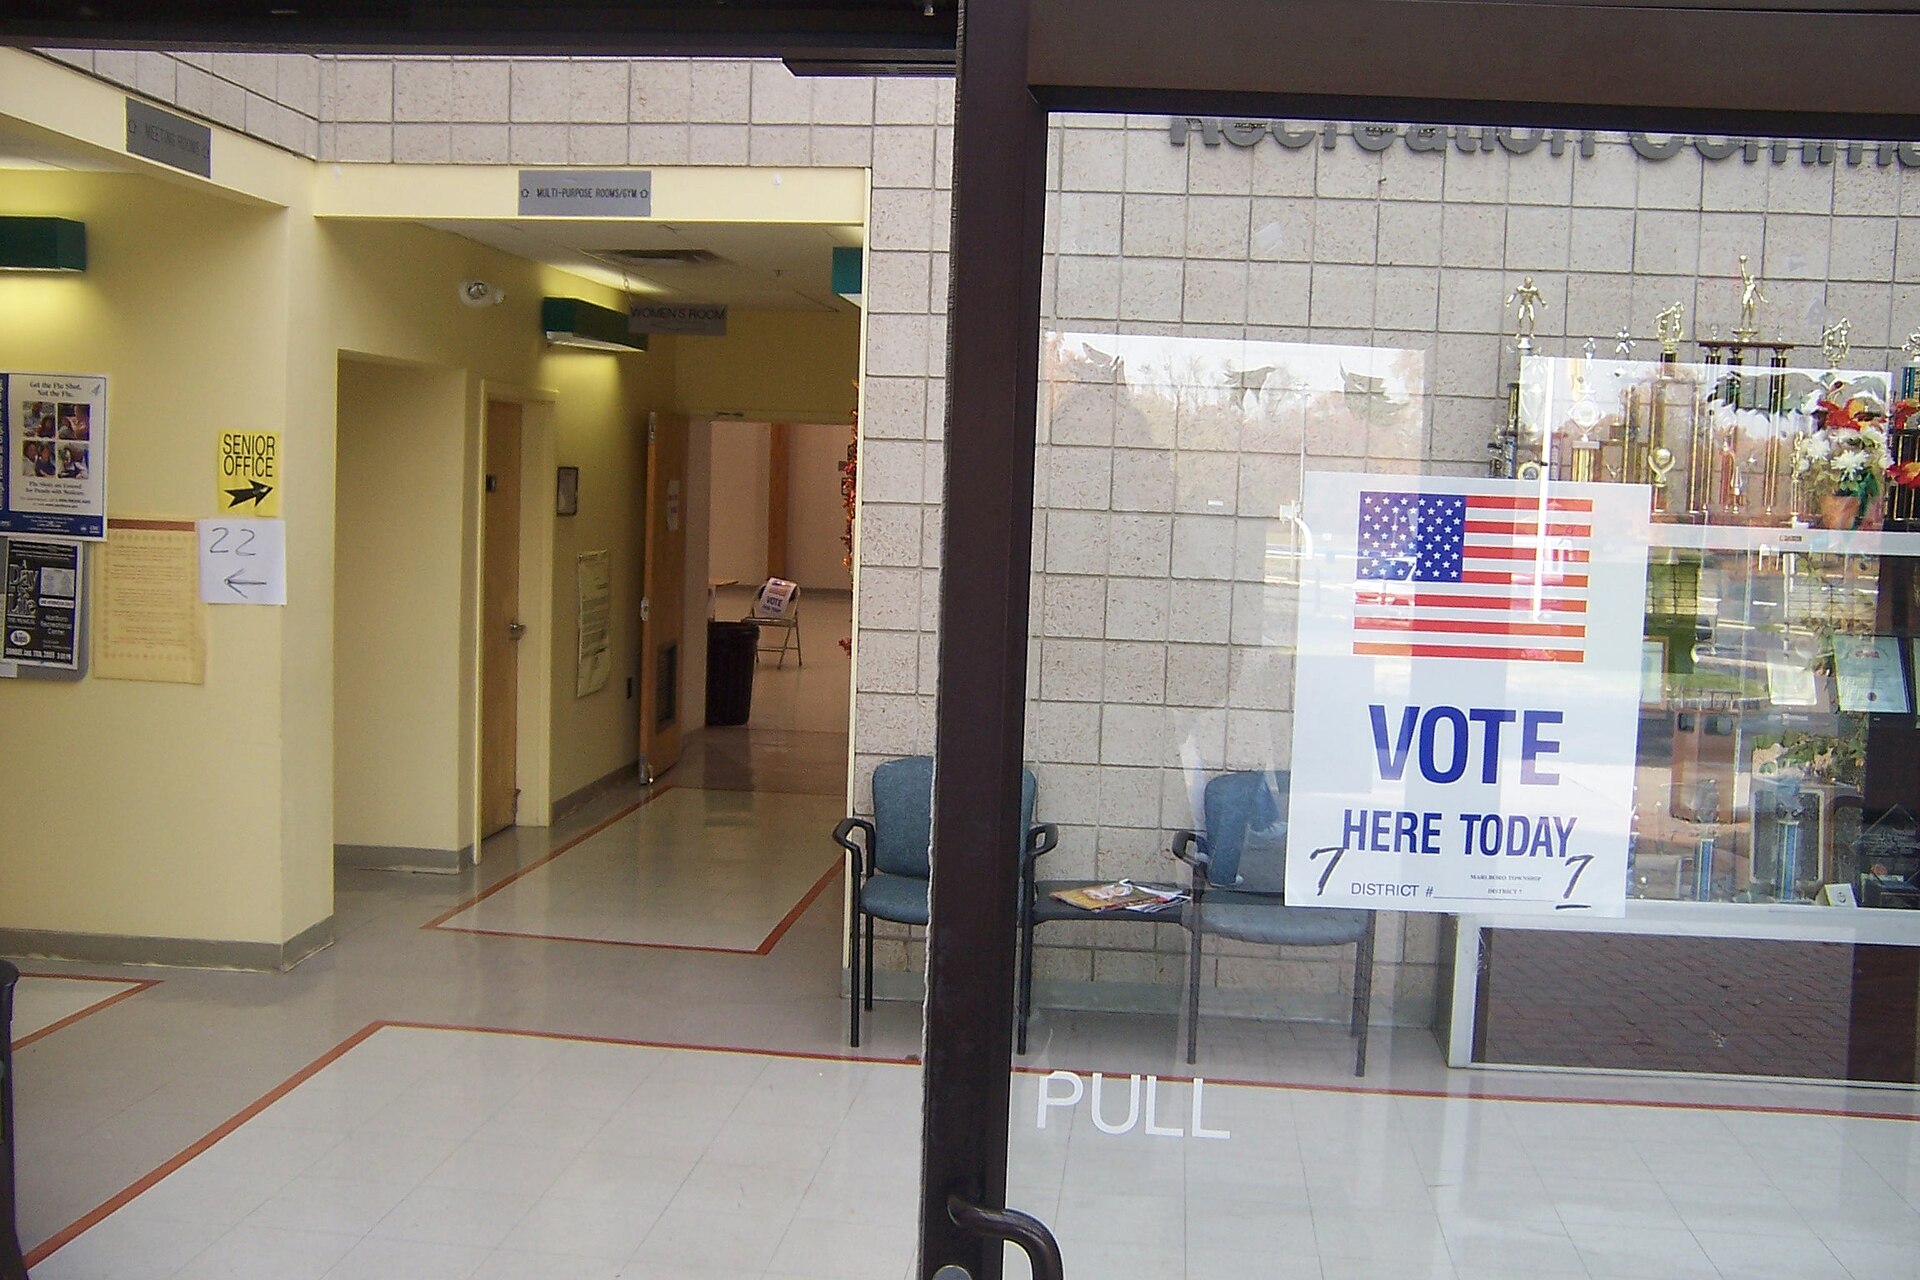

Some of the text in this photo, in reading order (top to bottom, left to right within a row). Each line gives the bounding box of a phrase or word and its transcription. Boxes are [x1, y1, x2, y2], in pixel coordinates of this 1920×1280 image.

[536, 187, 638, 199] MULTI-PURPOSE ROOMS/GYM
[688, 308, 727, 320] ROOM
[223, 433, 275, 456] SENIOR
[223, 455, 273, 477] OFFICE
[209, 527, 256, 557] 22
[766, 596, 783, 607] VOTE
[1368, 704, 1564, 785] VOTE
[1343, 809, 1578, 858] HERE TODAY
[1310, 846, 1345, 896] 7
[1565, 854, 1594, 899] 7
[1351, 883, 1434, 897] DISTRICT #
[1037, 1070, 1231, 1140] PULL
